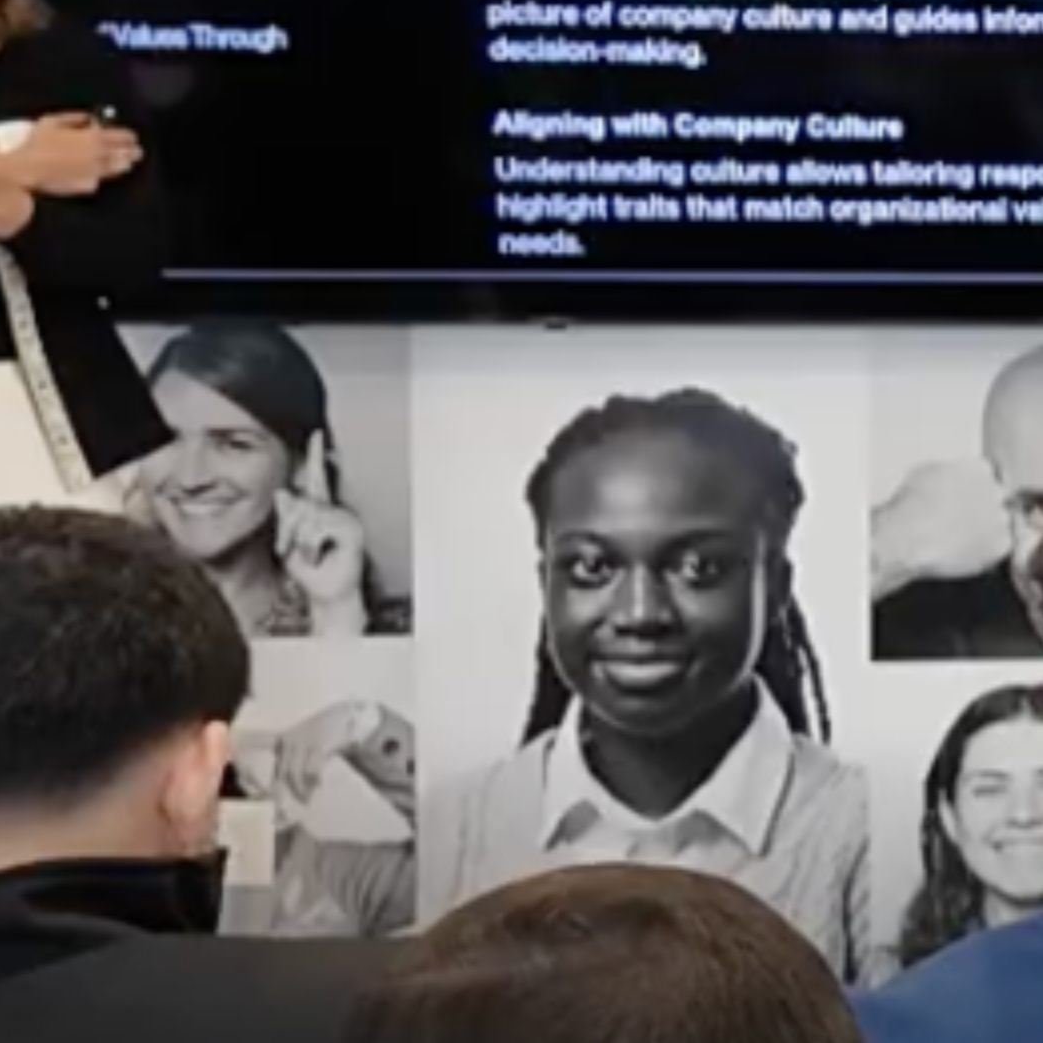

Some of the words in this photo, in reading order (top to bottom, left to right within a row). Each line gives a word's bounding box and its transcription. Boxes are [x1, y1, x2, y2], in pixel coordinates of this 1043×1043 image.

[586, 0, 612, 28] of
[619, 5, 736, 38] company
[743, 2, 833, 31] culture
[839, 4, 887, 33] and
[893, 4, 978, 37] guides
[190, 23, 288, 52] Through
[487, 36, 707, 70] decision-making.
[492, 109, 606, 142] Aligning
[611, 111, 668, 138] with
[674, 111, 800, 145] Company
[806, 112, 904, 141] Culture
[494, 156, 684, 190] Understanding
[691, 157, 779, 183] culture
[786, 157, 866, 184] allows
[872, 159, 975, 191] tailoring
[497, 192, 607, 225] highlight
[614, 192, 680, 221] traits
[687, 193, 738, 221] that
[745, 194, 823, 222] match
[830, 195, 1007, 227] organizational
[498, 229, 586, 256] needs.
